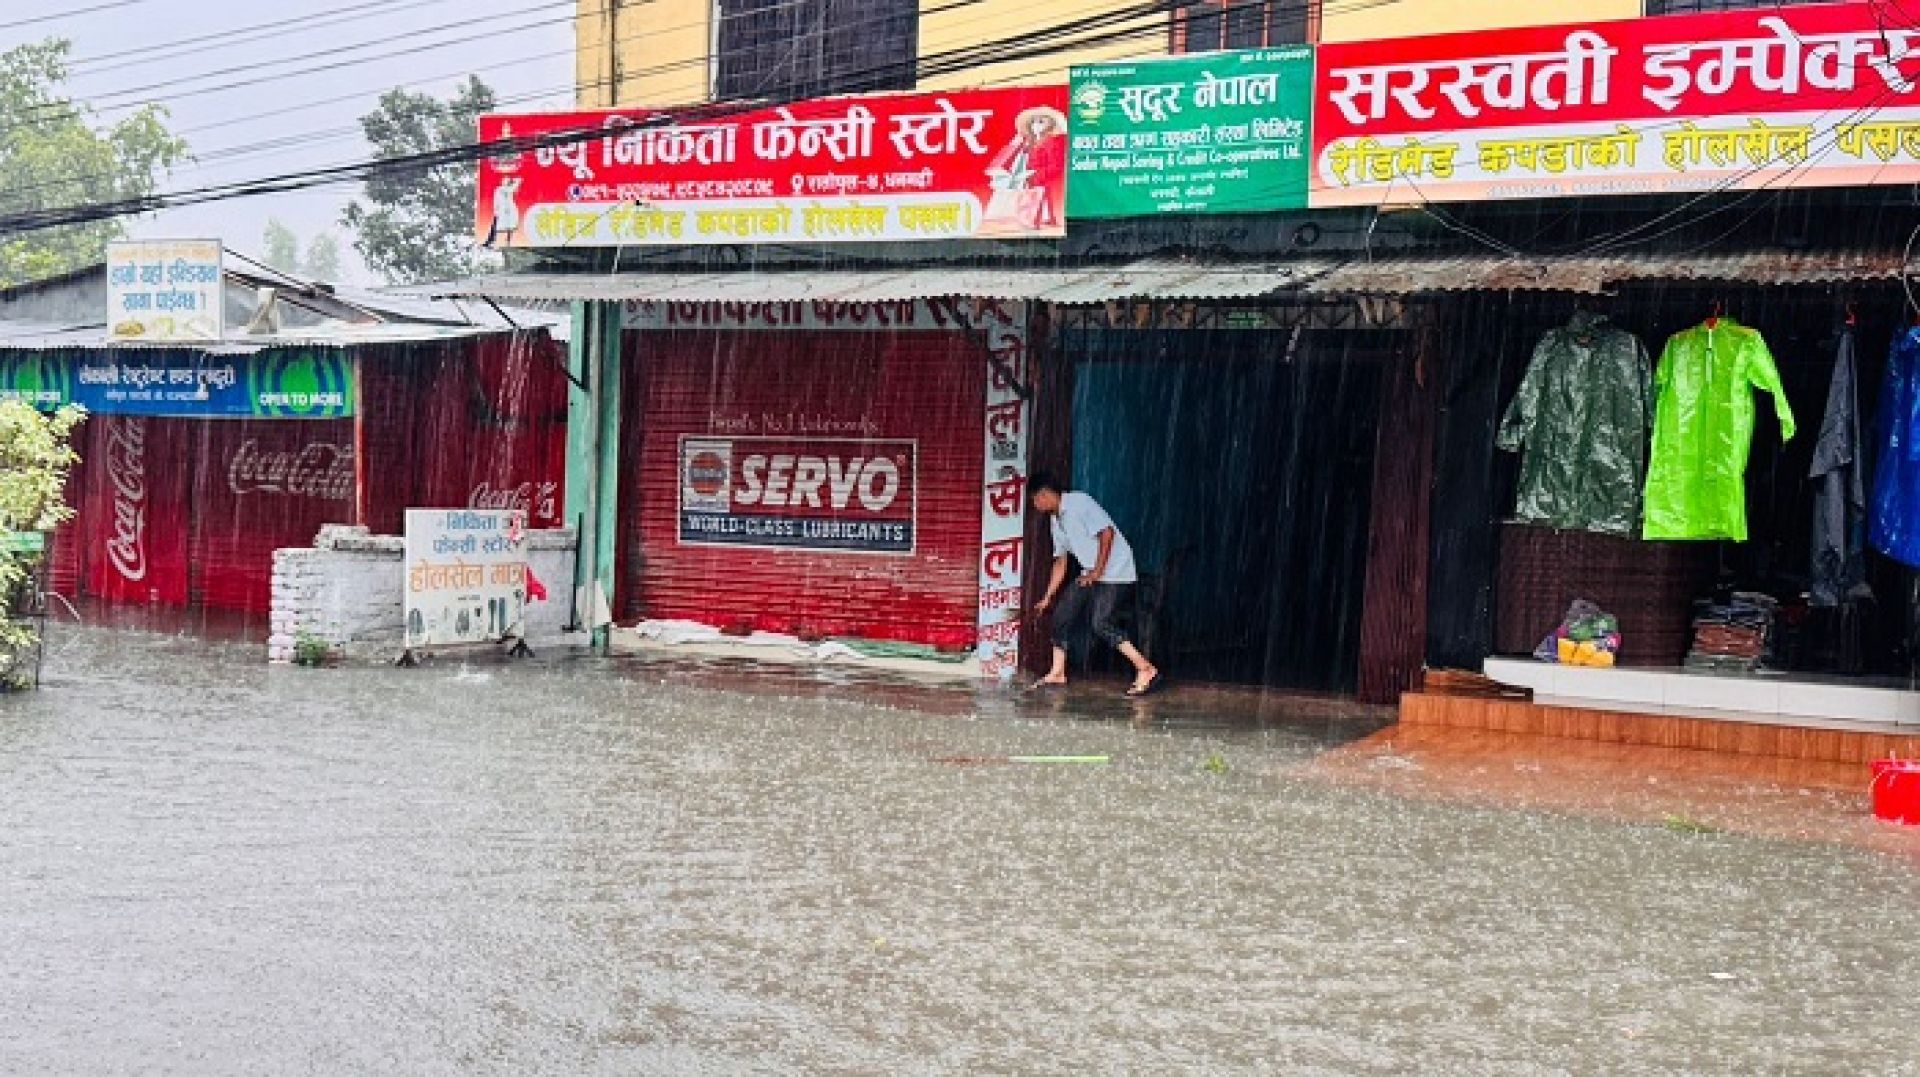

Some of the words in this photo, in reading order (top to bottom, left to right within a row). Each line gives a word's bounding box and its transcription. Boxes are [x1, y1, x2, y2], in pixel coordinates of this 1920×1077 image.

[1119, 82, 1185, 122] सुदूर
[1193, 71, 1280, 107] नेपाल
[1330, 30, 1619, 124] सरस्वती
[751, 106, 876, 162] फेन्सी
[889, 98, 993, 159] स्टोर
[1475, 124, 1641, 173] कपडाको
[1662, 118, 1815, 172] होलसेल
[735, 454, 899, 511] SERVO
[688, 514, 794, 536] WORLD-CLASS
[803, 519, 904, 541] LUBRICANTS
